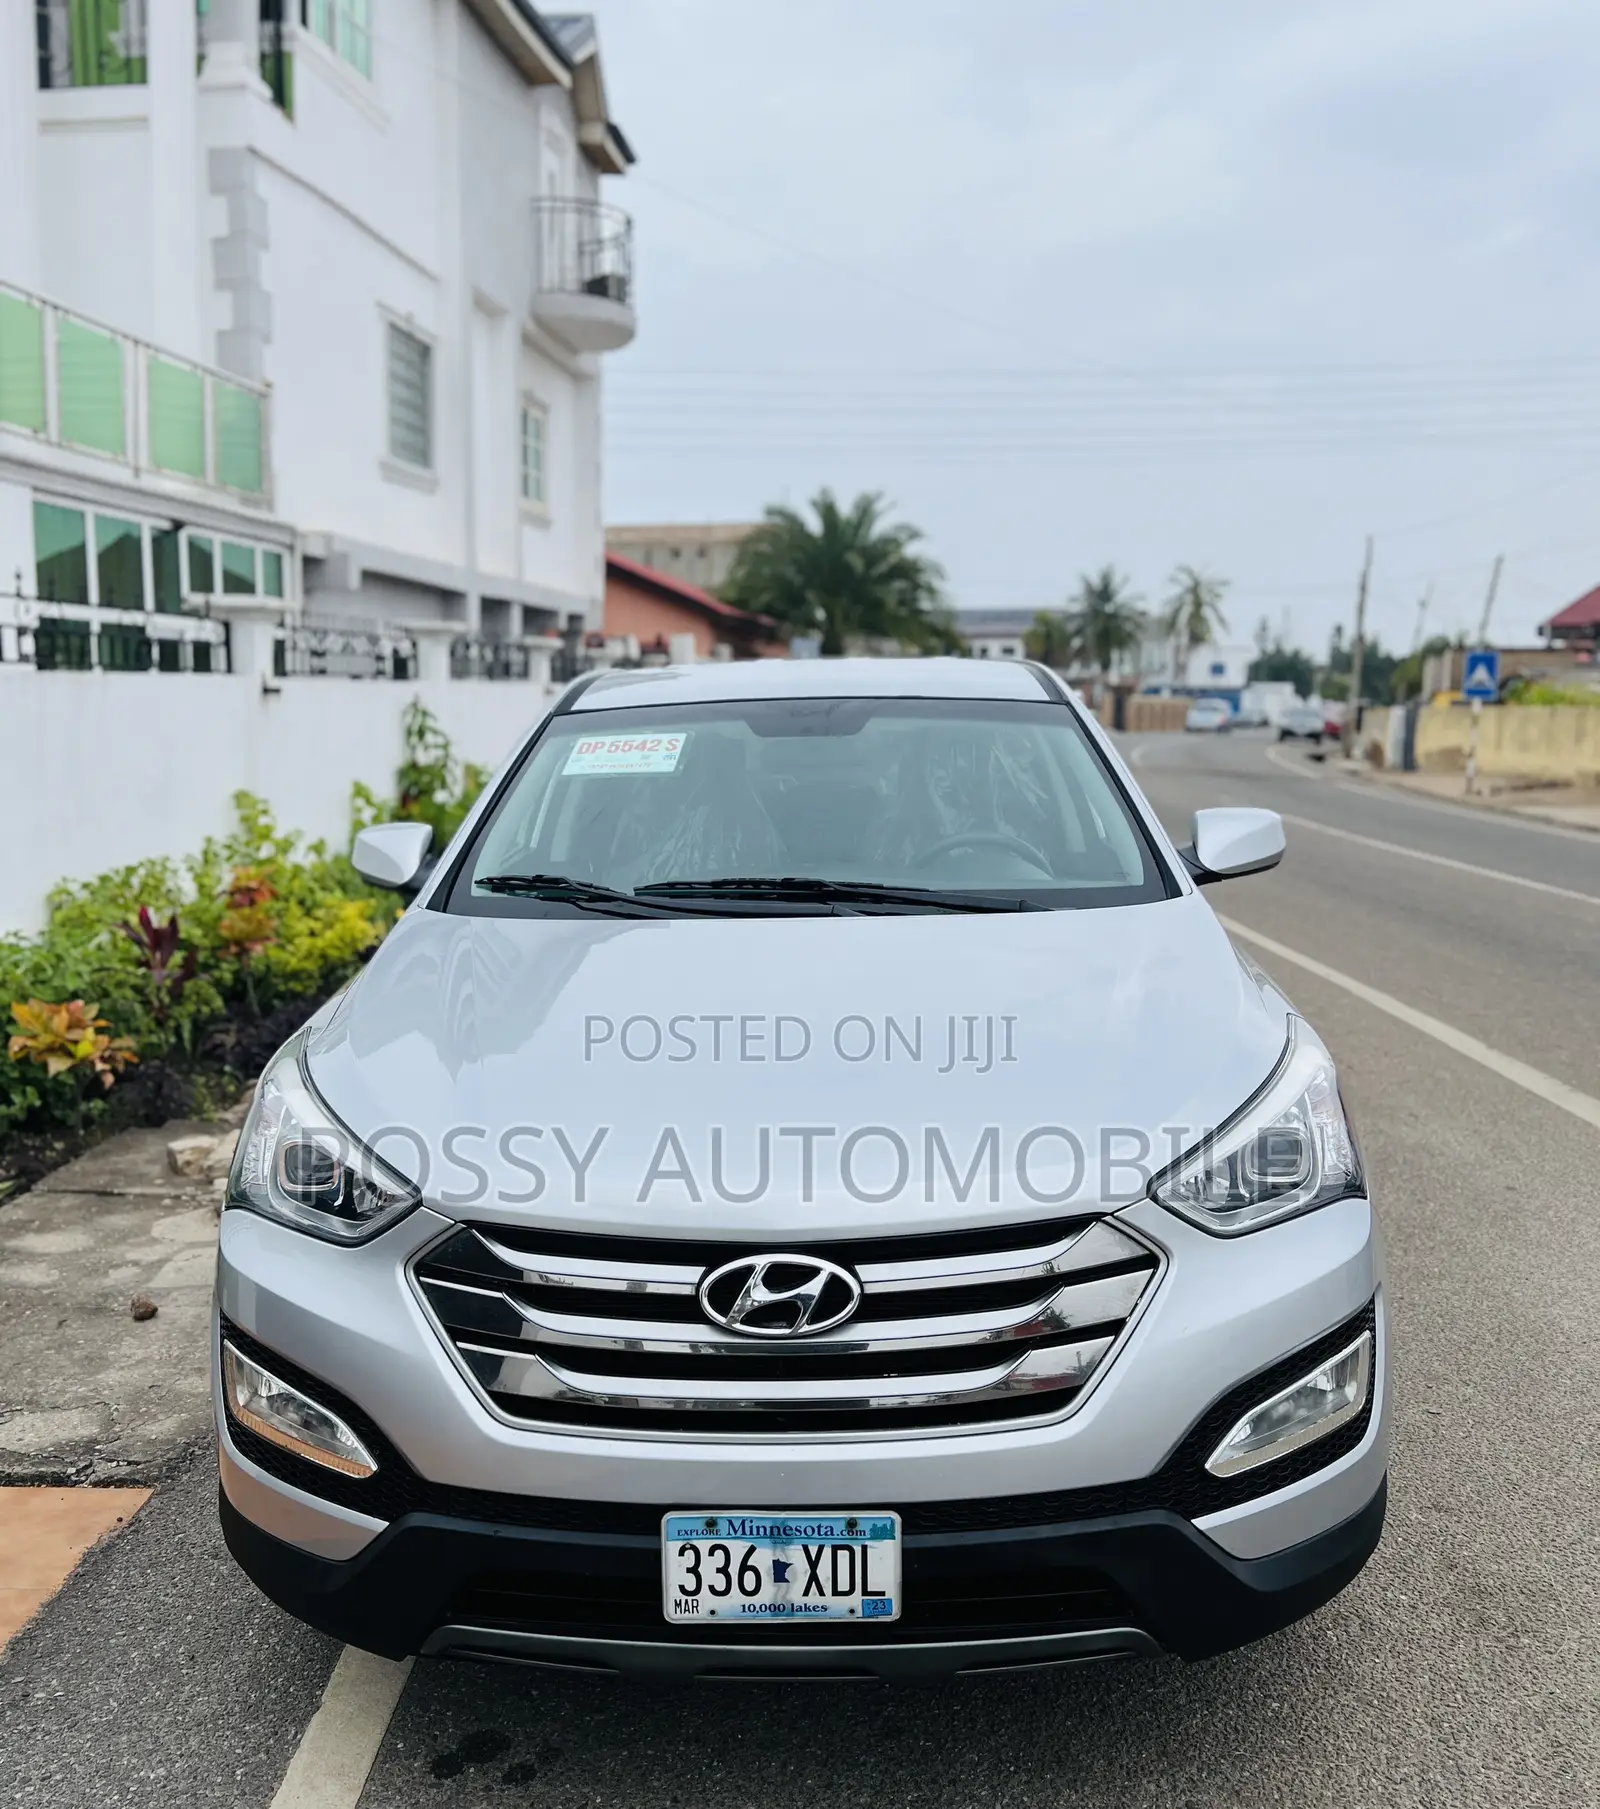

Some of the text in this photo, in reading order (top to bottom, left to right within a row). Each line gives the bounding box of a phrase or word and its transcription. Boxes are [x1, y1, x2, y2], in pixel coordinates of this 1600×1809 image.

[607, 738, 662, 754] 5542
[665, 738, 680, 752] S
[677, 1528, 721, 1537] EXPLORE
[677, 1543, 886, 1597] 336 XDL
[674, 1598, 699, 1614] MAR
[740, 1602, 828, 1614] 10,000 lakes
[871, 1600, 887, 1610] 23
